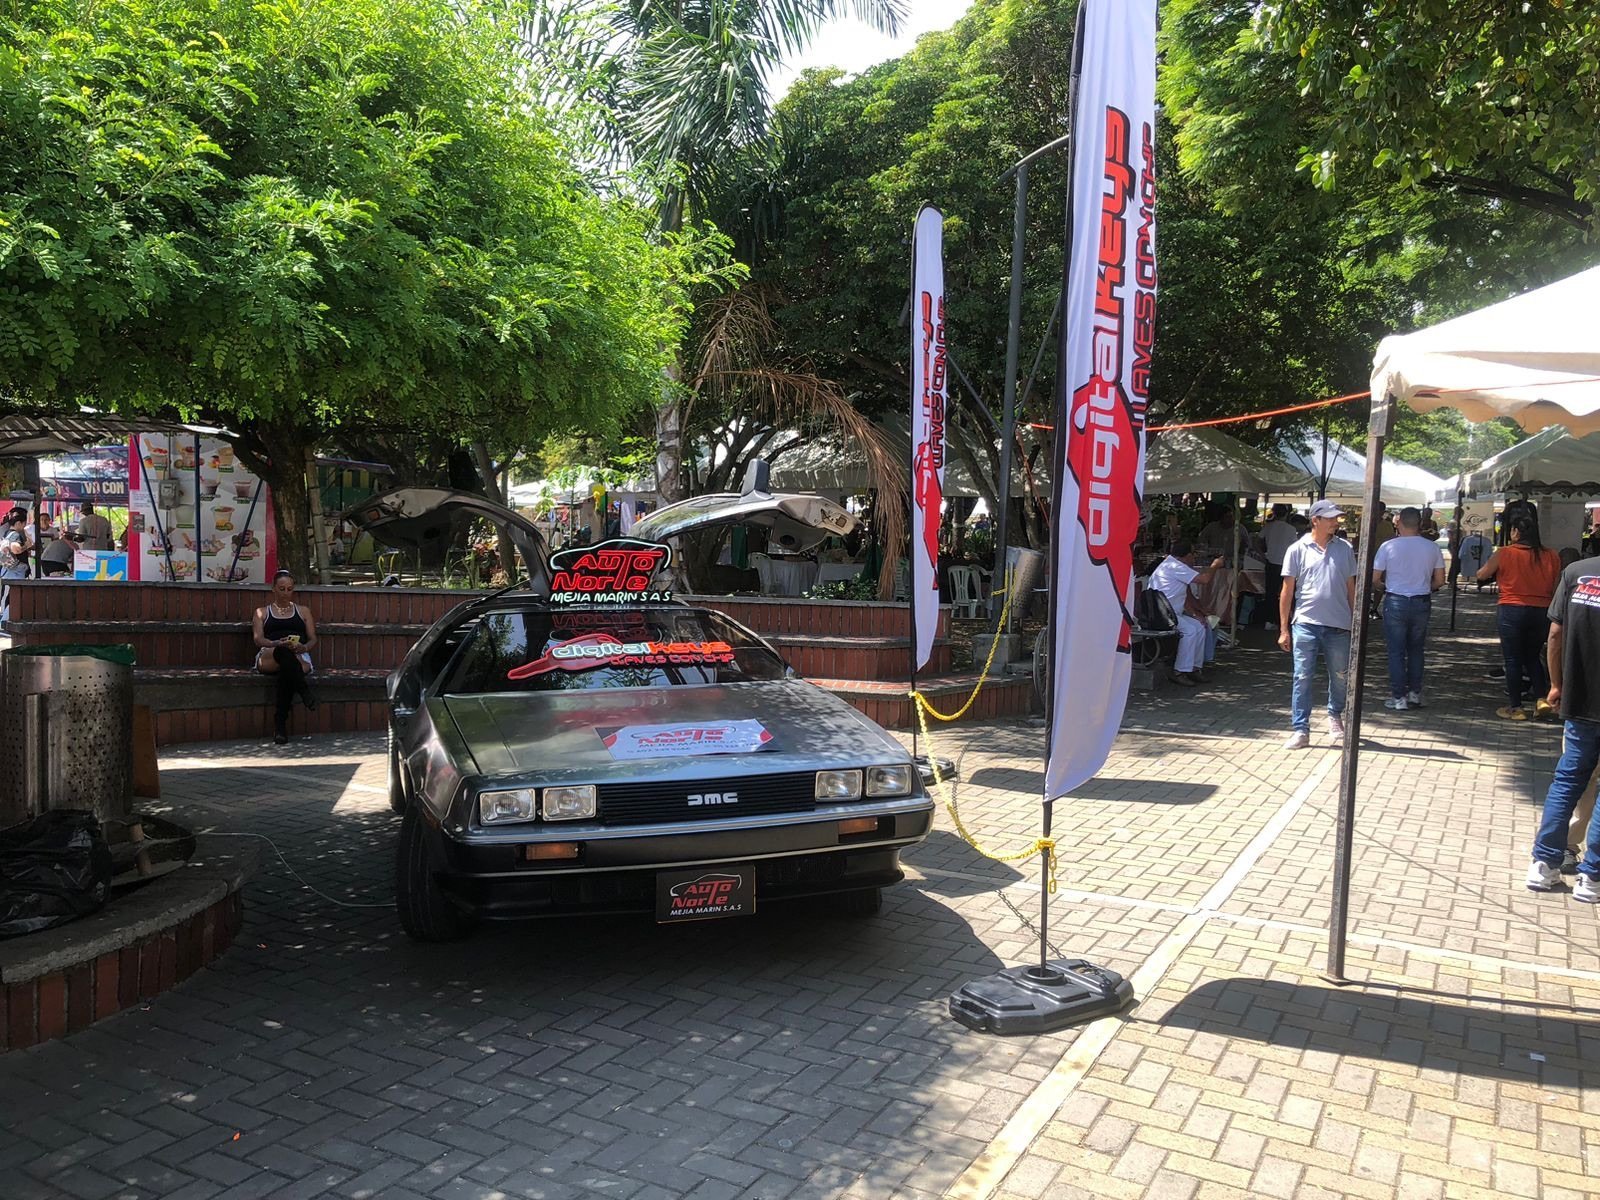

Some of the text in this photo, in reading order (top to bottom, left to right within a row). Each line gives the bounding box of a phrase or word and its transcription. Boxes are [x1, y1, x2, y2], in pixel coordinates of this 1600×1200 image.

[932, 345, 947, 391] CON
[102, 481, 124, 495] CON
[550, 592, 591, 603] MEJIA
[594, 592, 638, 604] MARIN
[669, 654, 702, 664] CON
[703, 654, 735, 663] CHIP
[670, 907, 694, 917] MEJIA
[695, 905, 722, 915] MARIN
